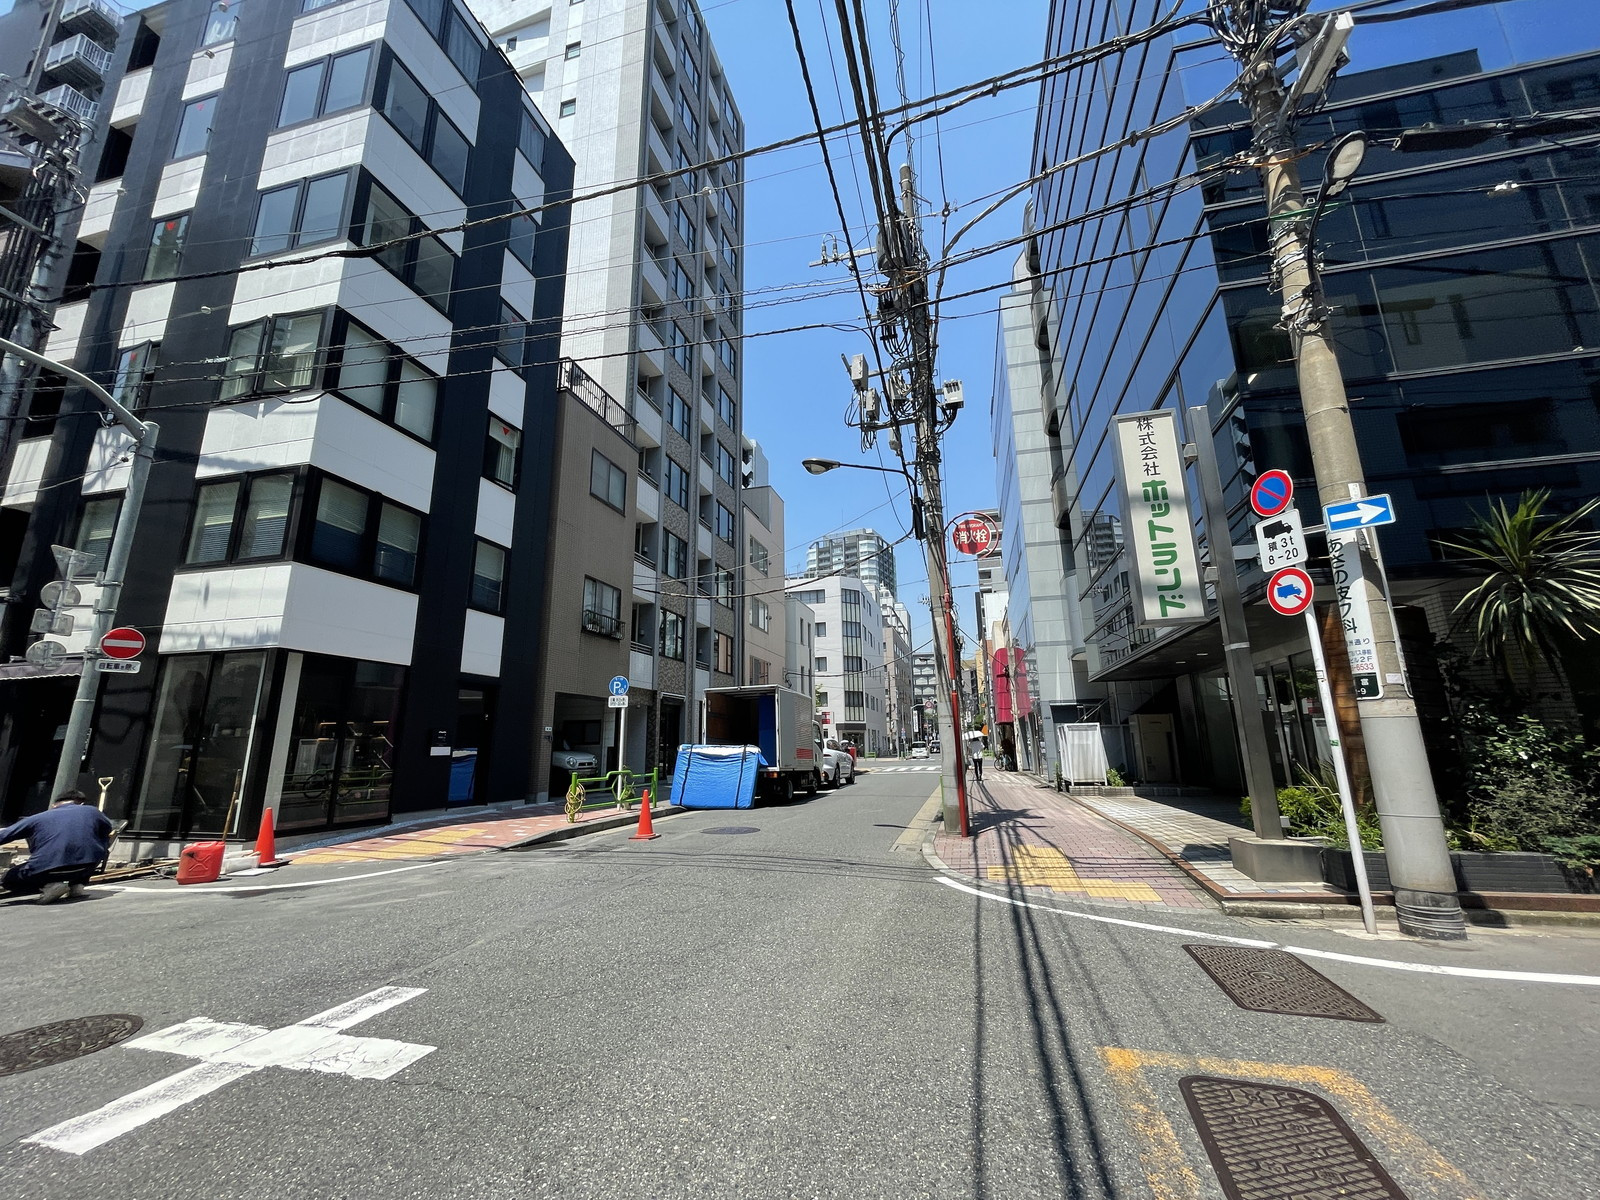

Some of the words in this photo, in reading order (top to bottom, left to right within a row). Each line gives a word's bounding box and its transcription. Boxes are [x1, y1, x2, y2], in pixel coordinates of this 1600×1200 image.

[1136, 417, 1161, 476] 株式会社
[956, 528, 988, 545] 消火栓
[1268, 547, 1299, 565] 8-20
